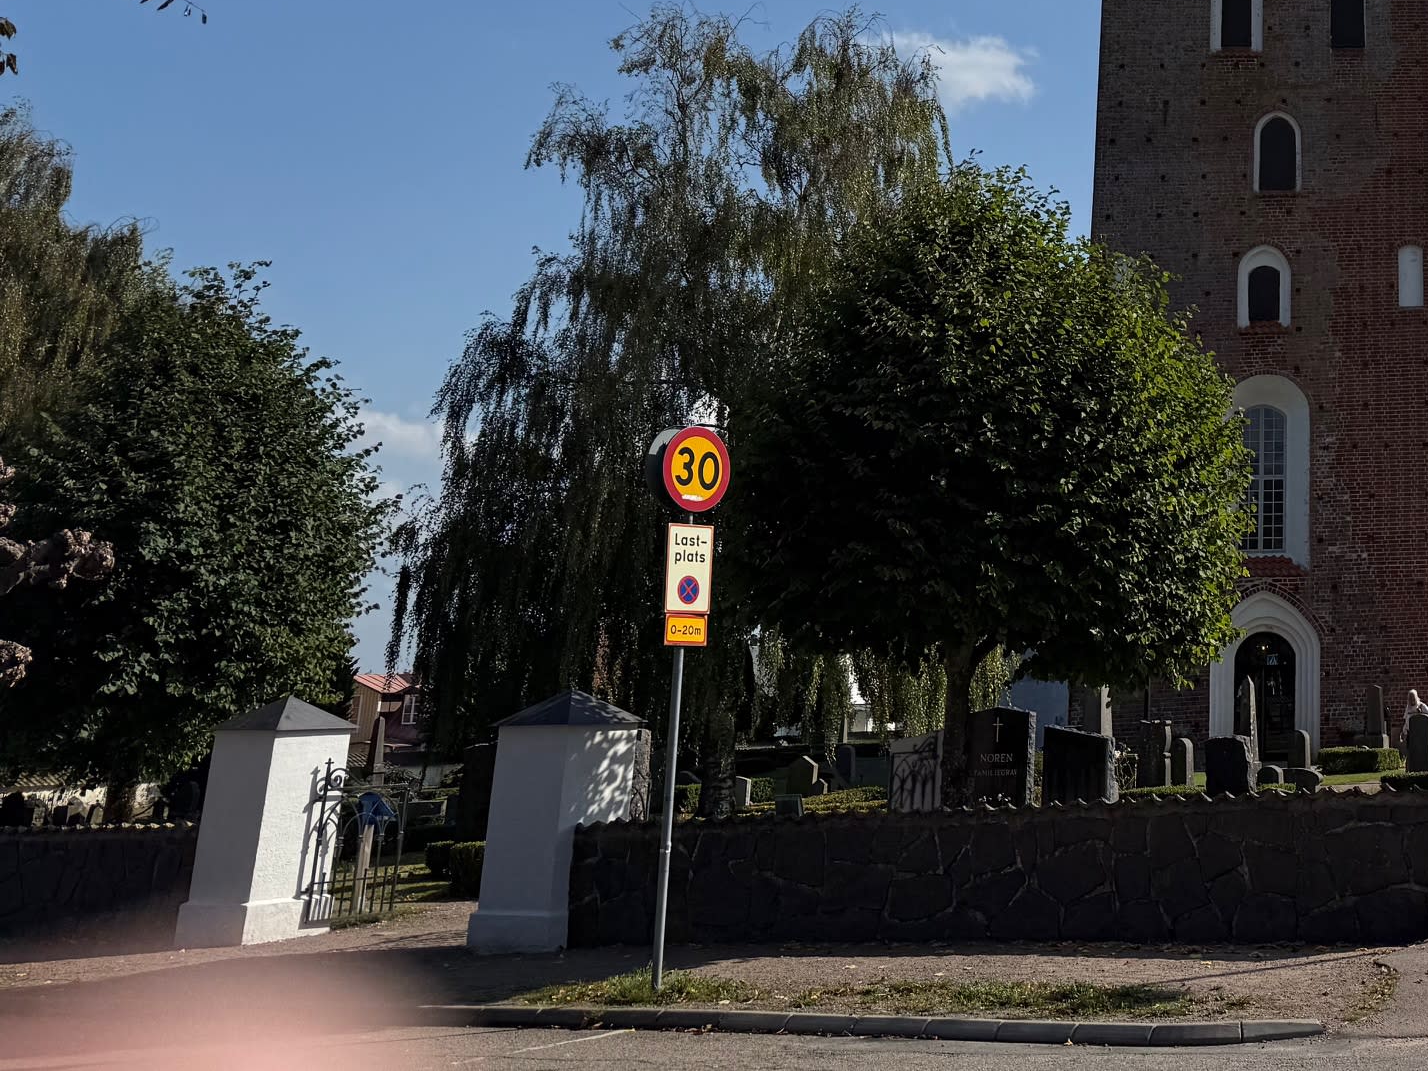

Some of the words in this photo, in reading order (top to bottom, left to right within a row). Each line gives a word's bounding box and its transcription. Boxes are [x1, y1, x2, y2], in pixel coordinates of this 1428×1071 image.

[675, 446, 720, 491] 30
[674, 532, 708, 547] Last-
[674, 548, 706, 564] plats
